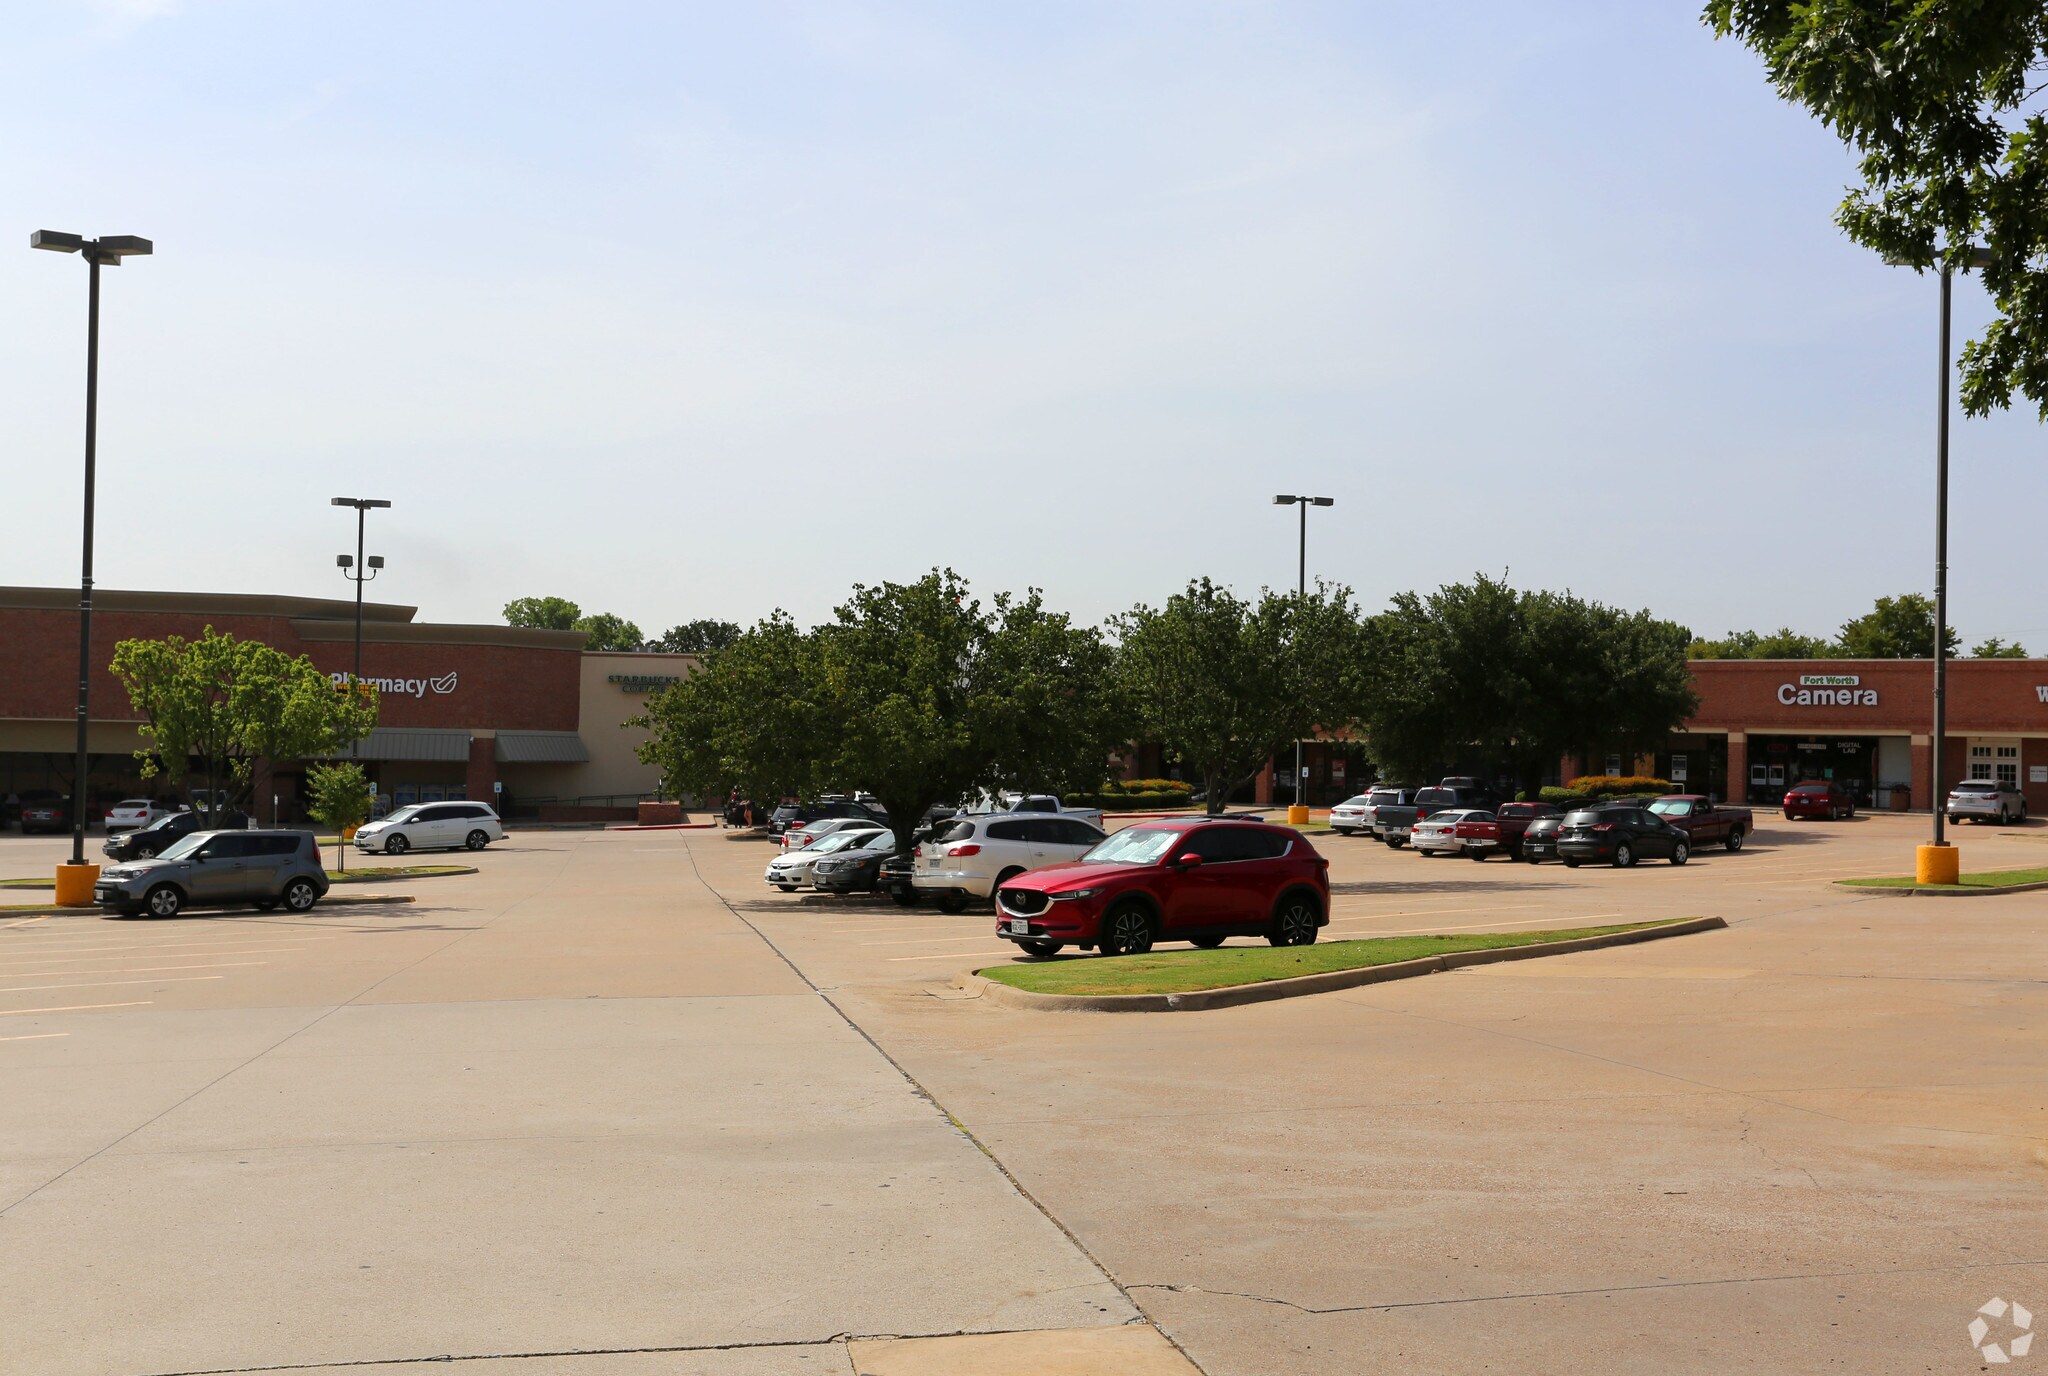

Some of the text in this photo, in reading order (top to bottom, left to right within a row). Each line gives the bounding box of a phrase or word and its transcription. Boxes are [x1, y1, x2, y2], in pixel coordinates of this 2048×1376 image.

[1804, 676, 1855, 684] Fort Worth
[1778, 684, 1877, 705] Camera
